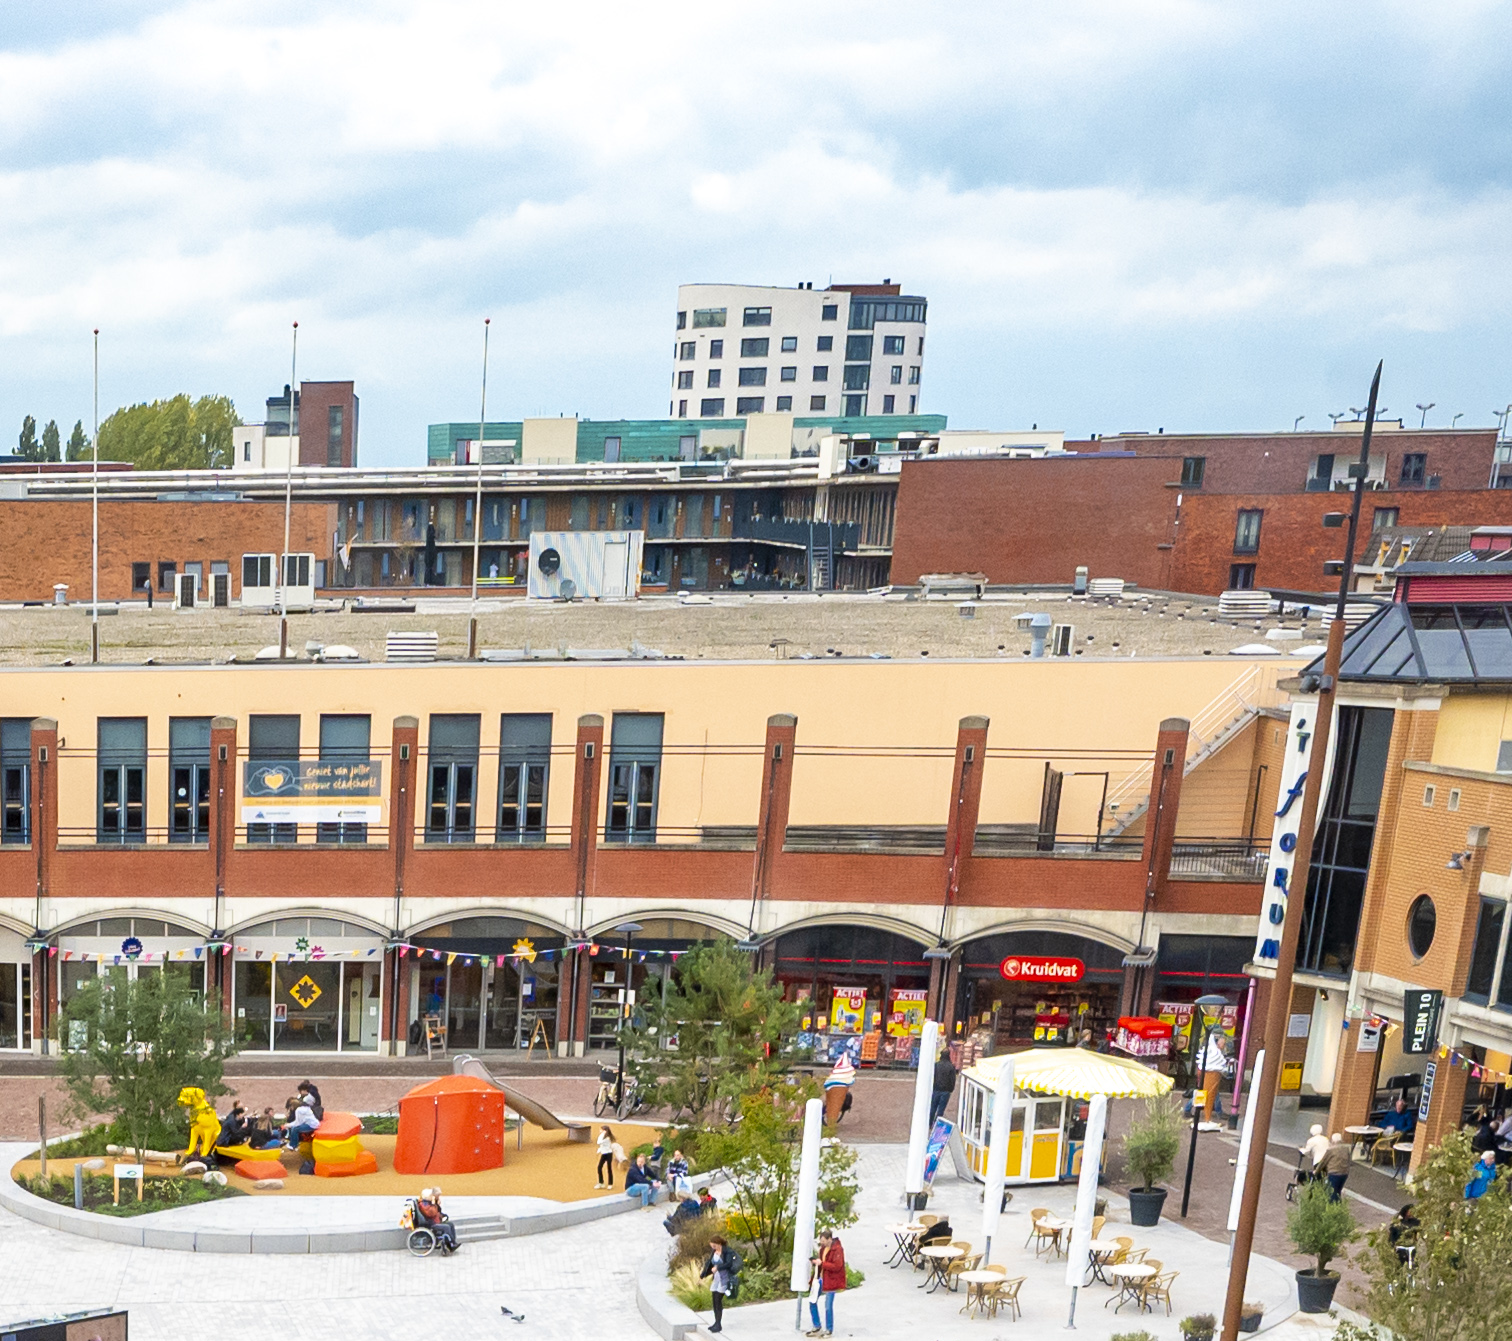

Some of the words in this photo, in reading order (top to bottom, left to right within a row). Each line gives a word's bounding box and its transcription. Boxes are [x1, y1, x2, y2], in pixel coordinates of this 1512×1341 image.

[1021, 963, 1078, 977] Kruidvat
[1419, 993, 1432, 1010] 10
[1411, 1012, 1429, 1052] PLEIN
